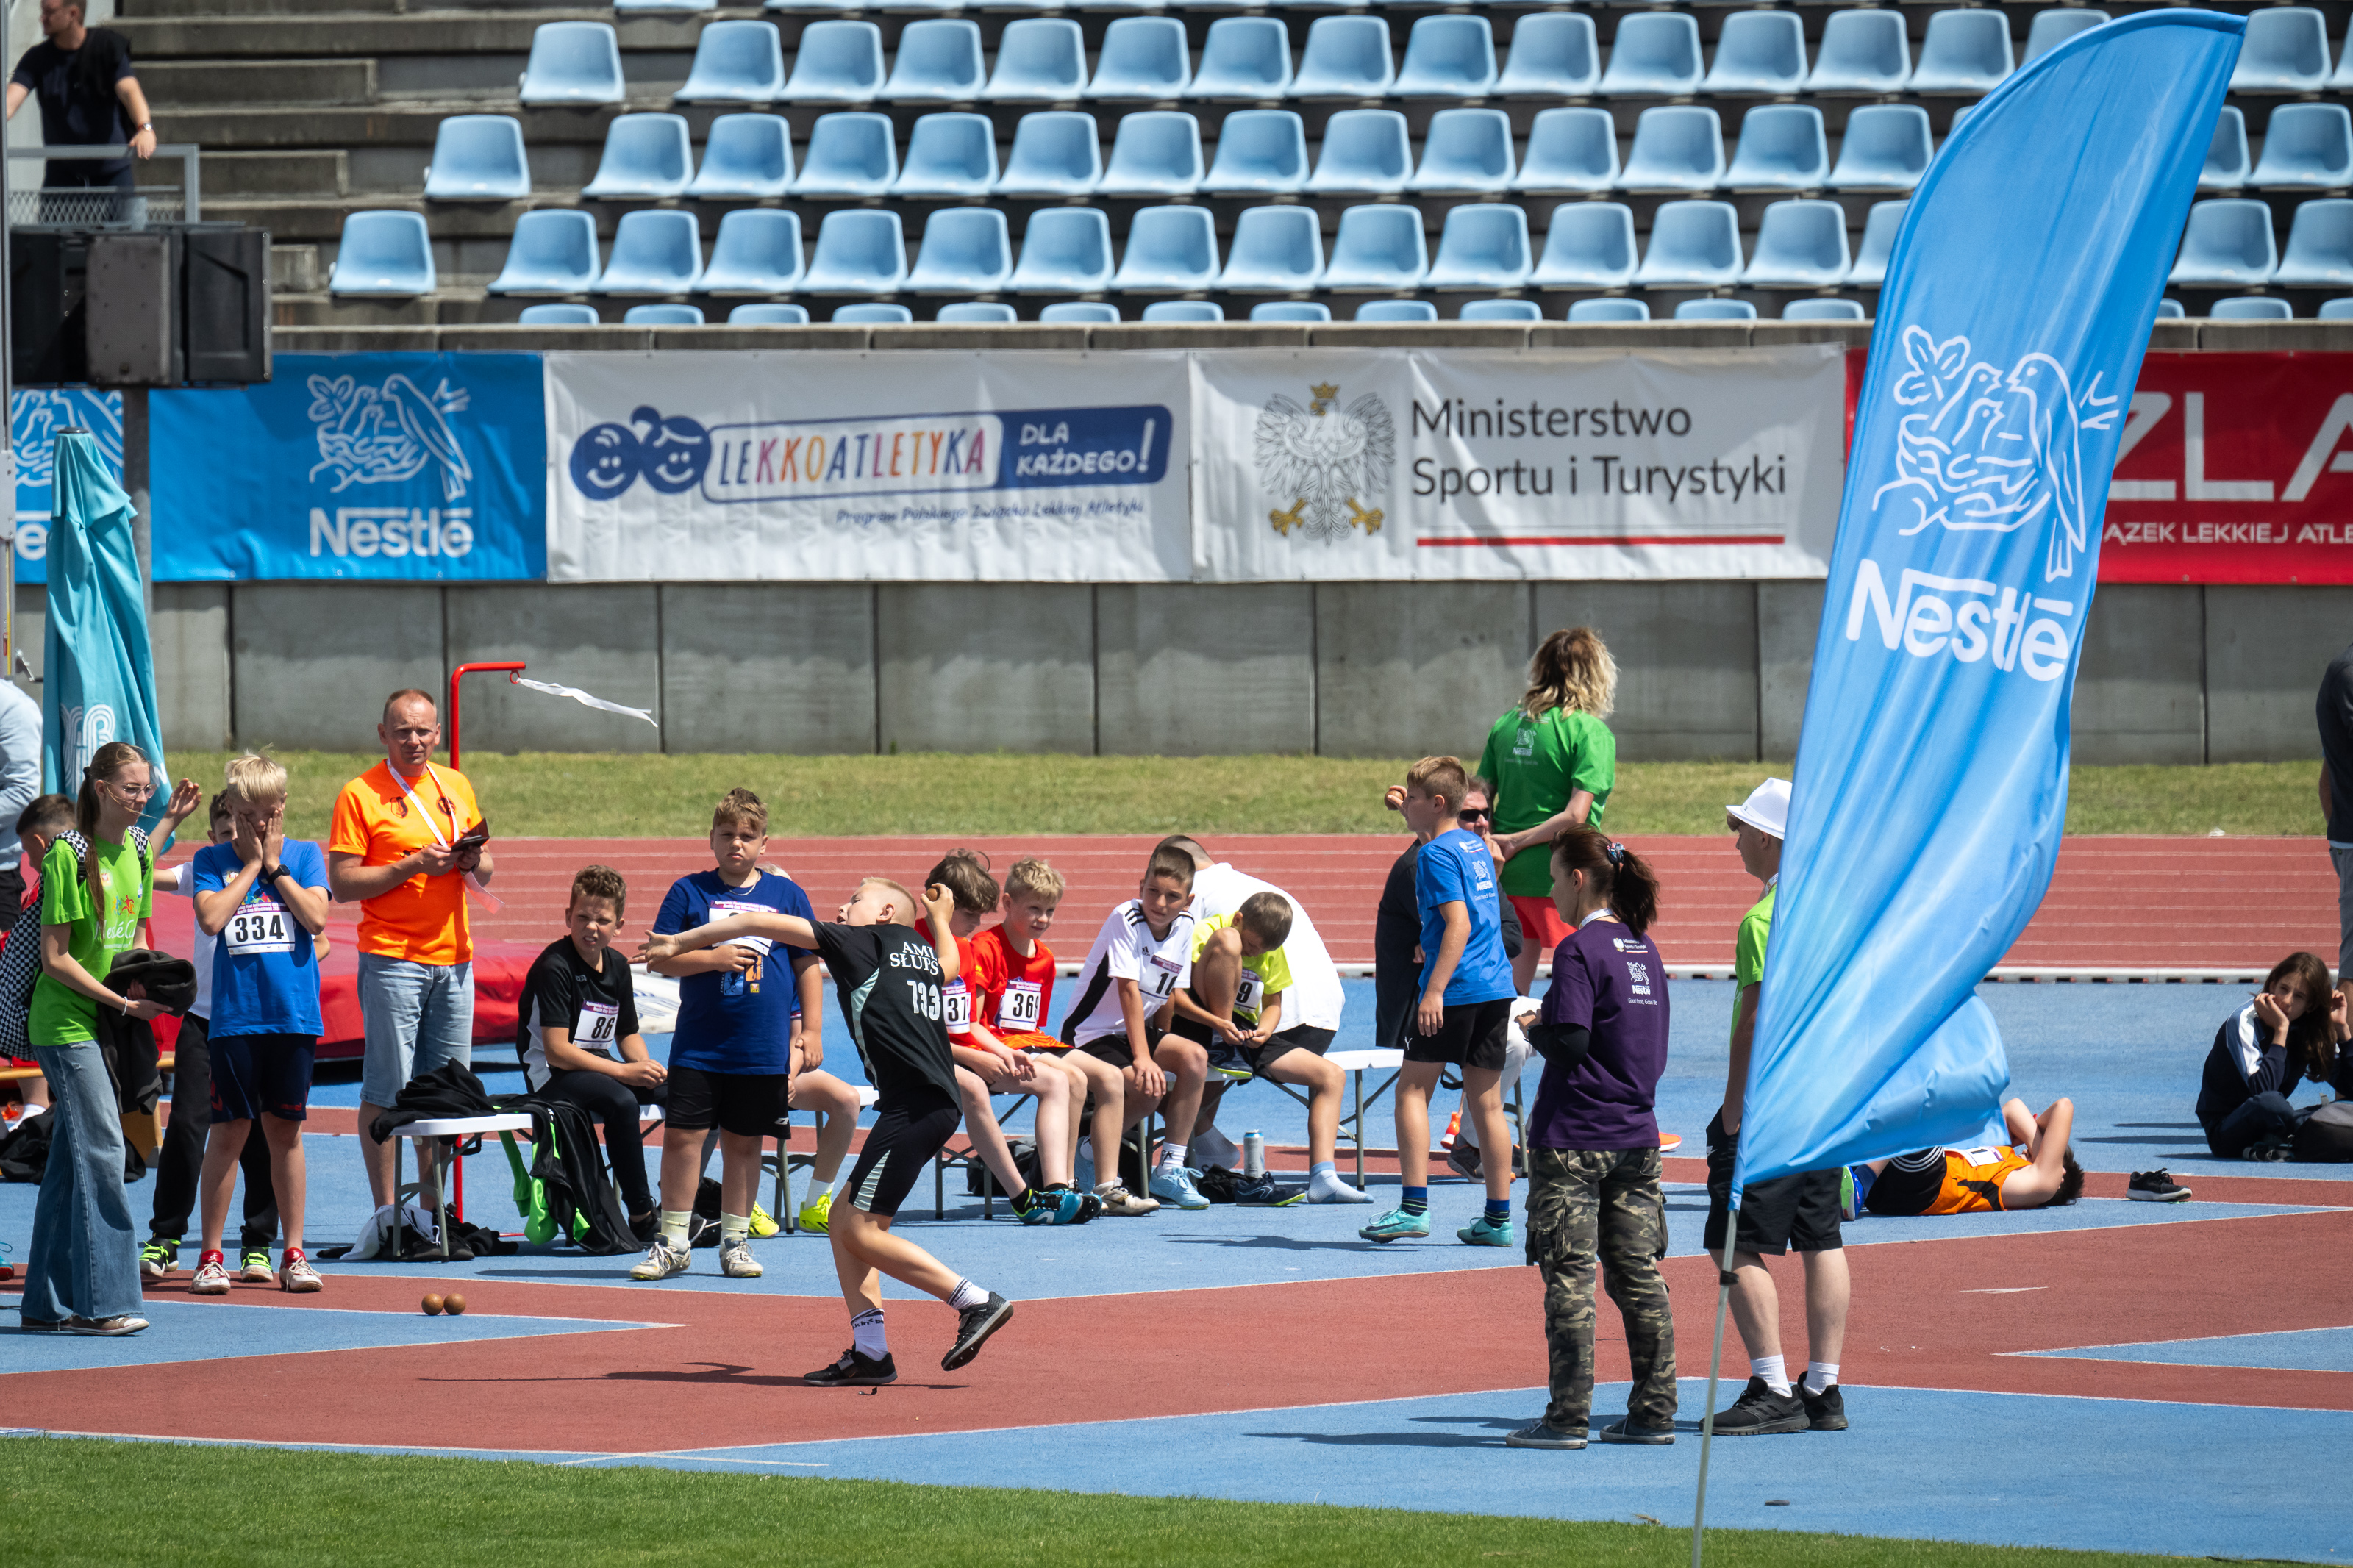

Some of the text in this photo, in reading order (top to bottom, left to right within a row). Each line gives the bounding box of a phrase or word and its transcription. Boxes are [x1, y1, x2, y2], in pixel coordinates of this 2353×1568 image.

[1411, 398, 1692, 439] Ministerstwo
[1019, 421, 1070, 446] DLA
[718, 428, 985, 485] LEKKOATLETYKA
[1412, 454, 1787, 504] Sportu i Turystyki
[2104, 522, 2353, 546] ĄZEK LEKKIEJ ATLE
[235, 915, 284, 942] 334
[1236, 981, 1253, 1003] 9
[591, 1017, 615, 1039] 86
